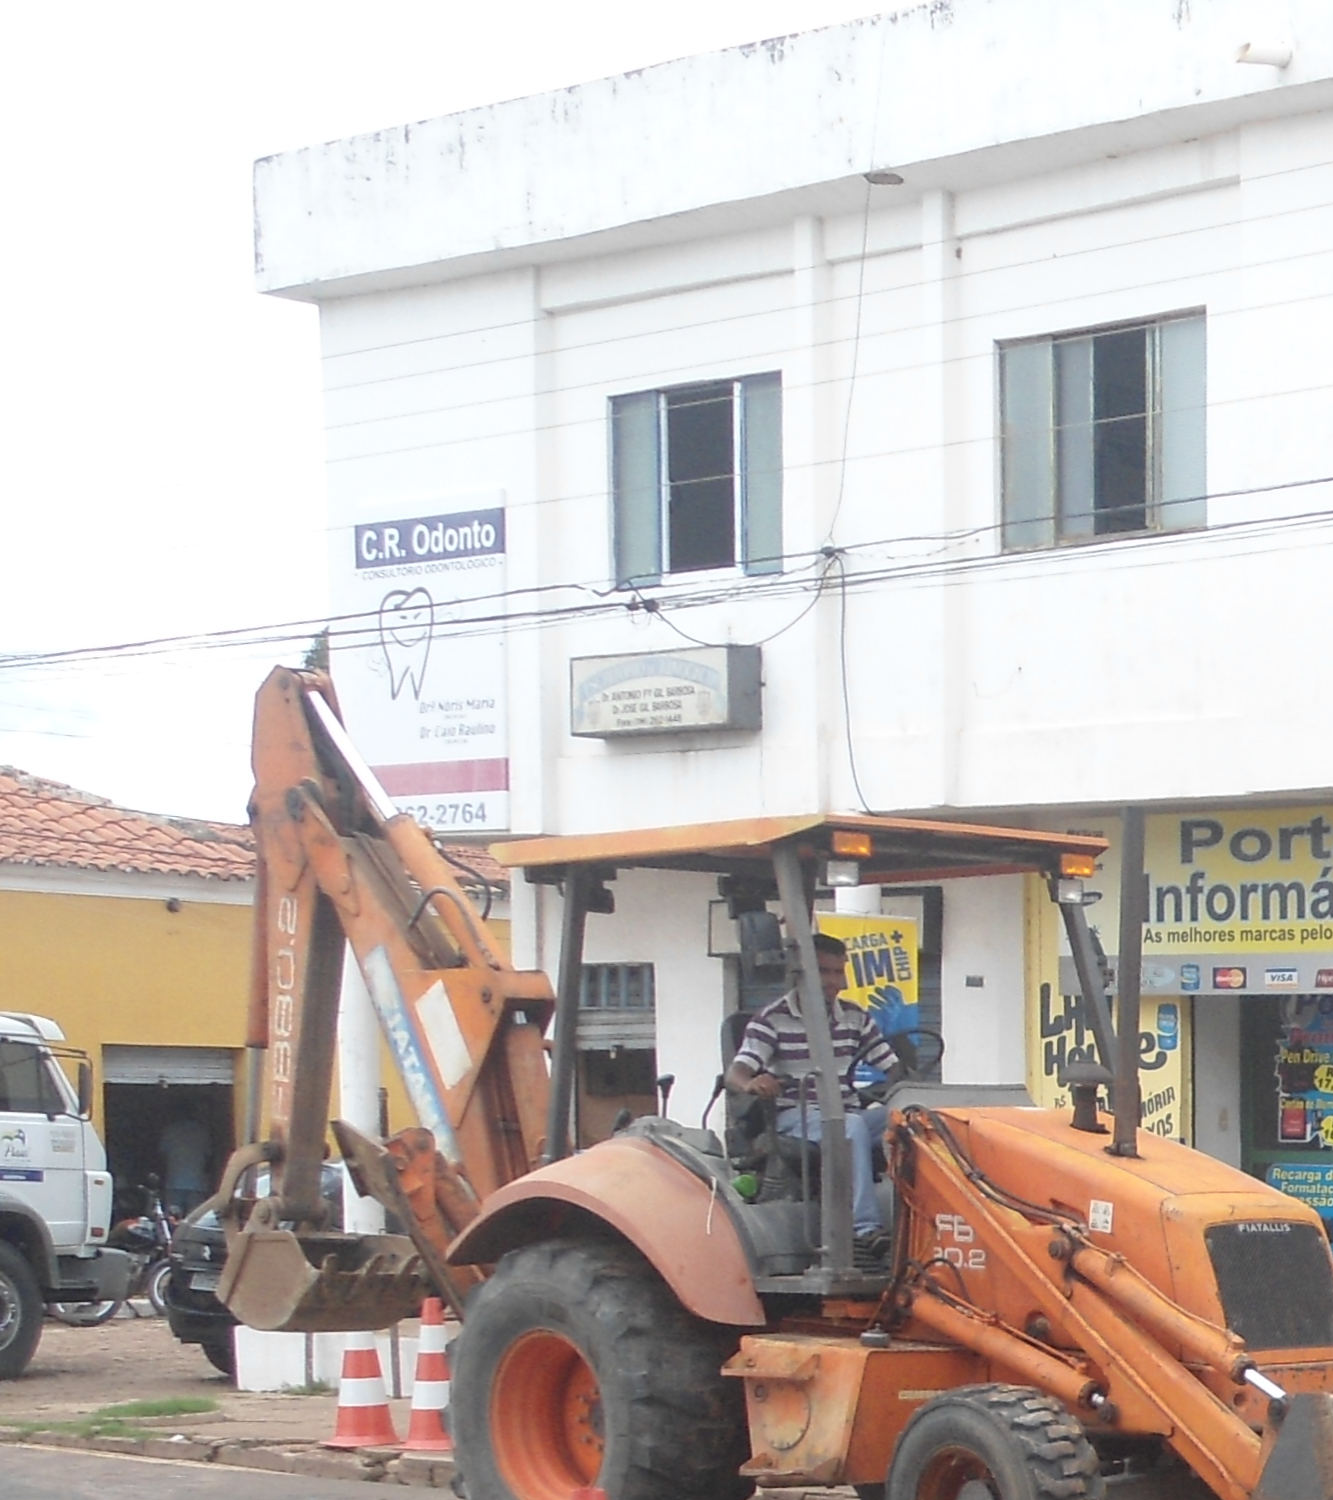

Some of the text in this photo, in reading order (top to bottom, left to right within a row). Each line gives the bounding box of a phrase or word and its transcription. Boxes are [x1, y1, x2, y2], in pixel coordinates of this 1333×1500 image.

[362, 519, 496, 561] C.R. Odonto
[1144, 928, 1163, 943] As
[1166, 925, 1235, 944] melhores
[1239, 927, 1296, 942] marcas
[1300, 923, 1333, 945] pelo
[893, 945, 912, 982] CHIP
[1270, 973, 1293, 982] VISA
[1281, 1048, 1300, 1063] Pen
[1303, 1049, 1331, 1064] Drive
[1272, 1168, 1322, 1183] Recarga
[1238, 1223, 1291, 1233] FIATALLIS
